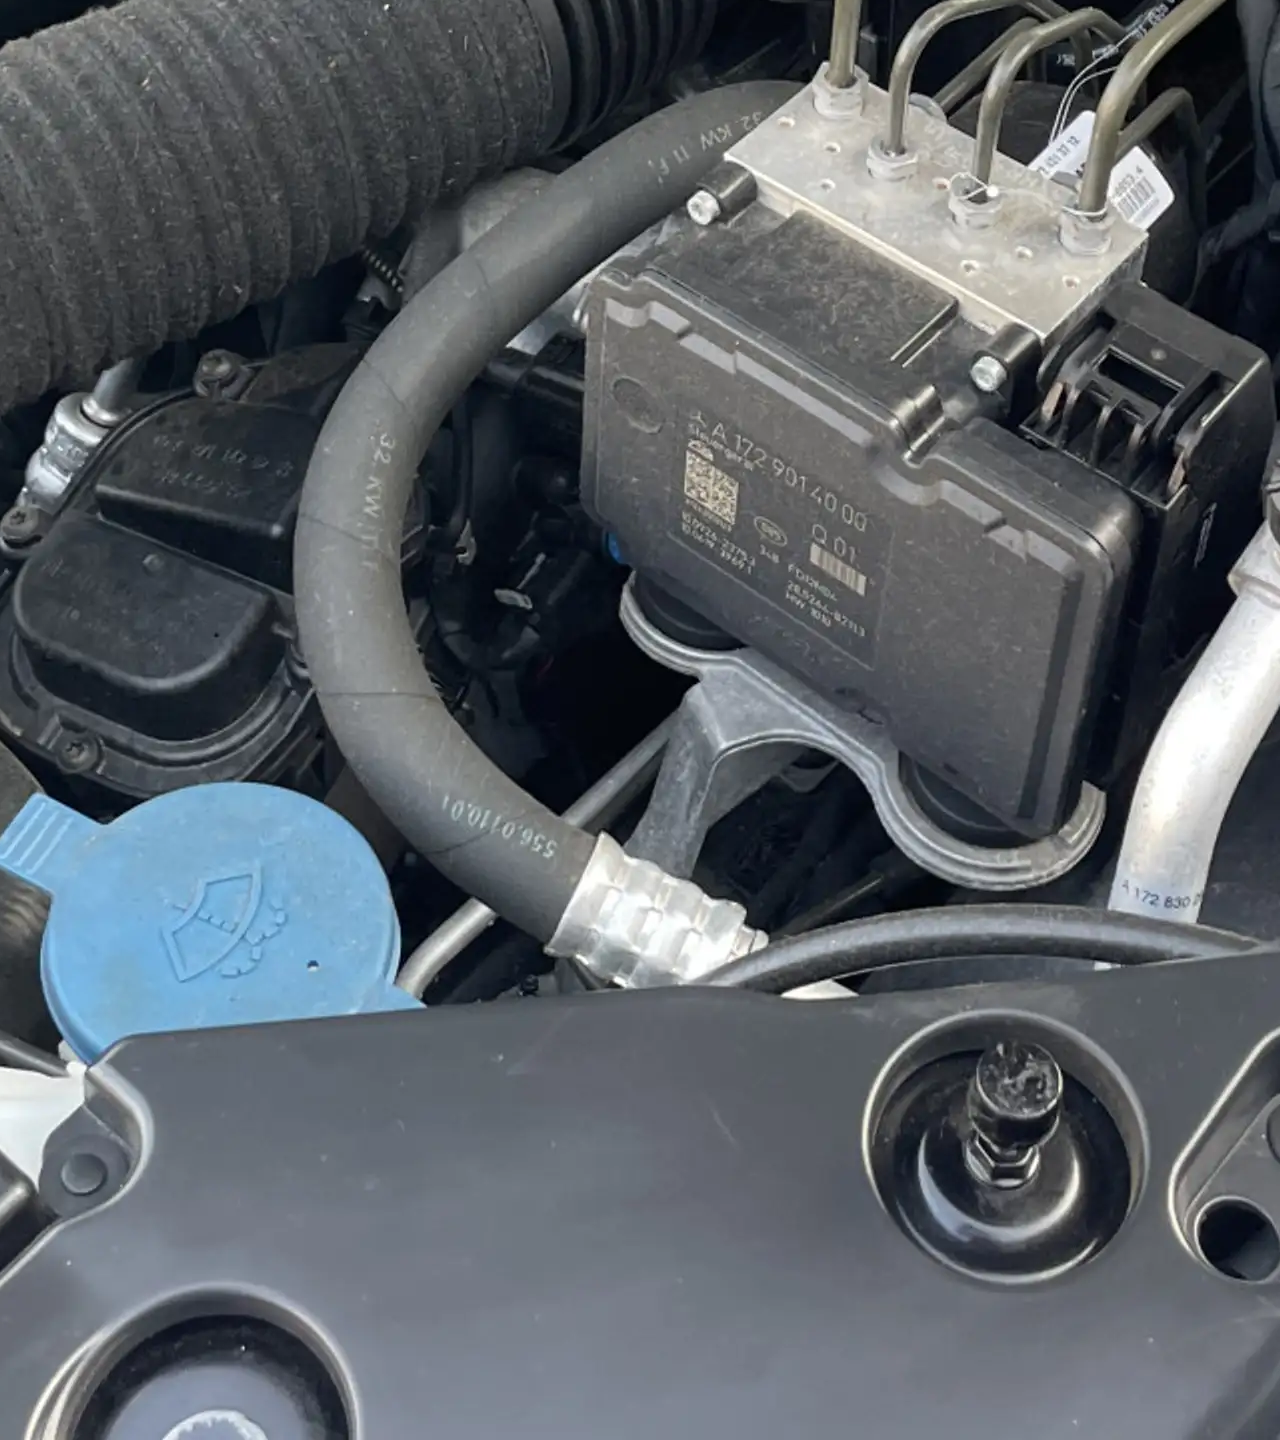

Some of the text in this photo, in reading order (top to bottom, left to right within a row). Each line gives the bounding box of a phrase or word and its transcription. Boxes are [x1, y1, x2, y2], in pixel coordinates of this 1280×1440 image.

[700, 122, 733, 152] KW
[711, 422, 728, 445] A
[736, 433, 767, 469] 172
[772, 458, 807, 493] 901
[810, 485, 838, 514] 40
[842, 504, 868, 533] 00
